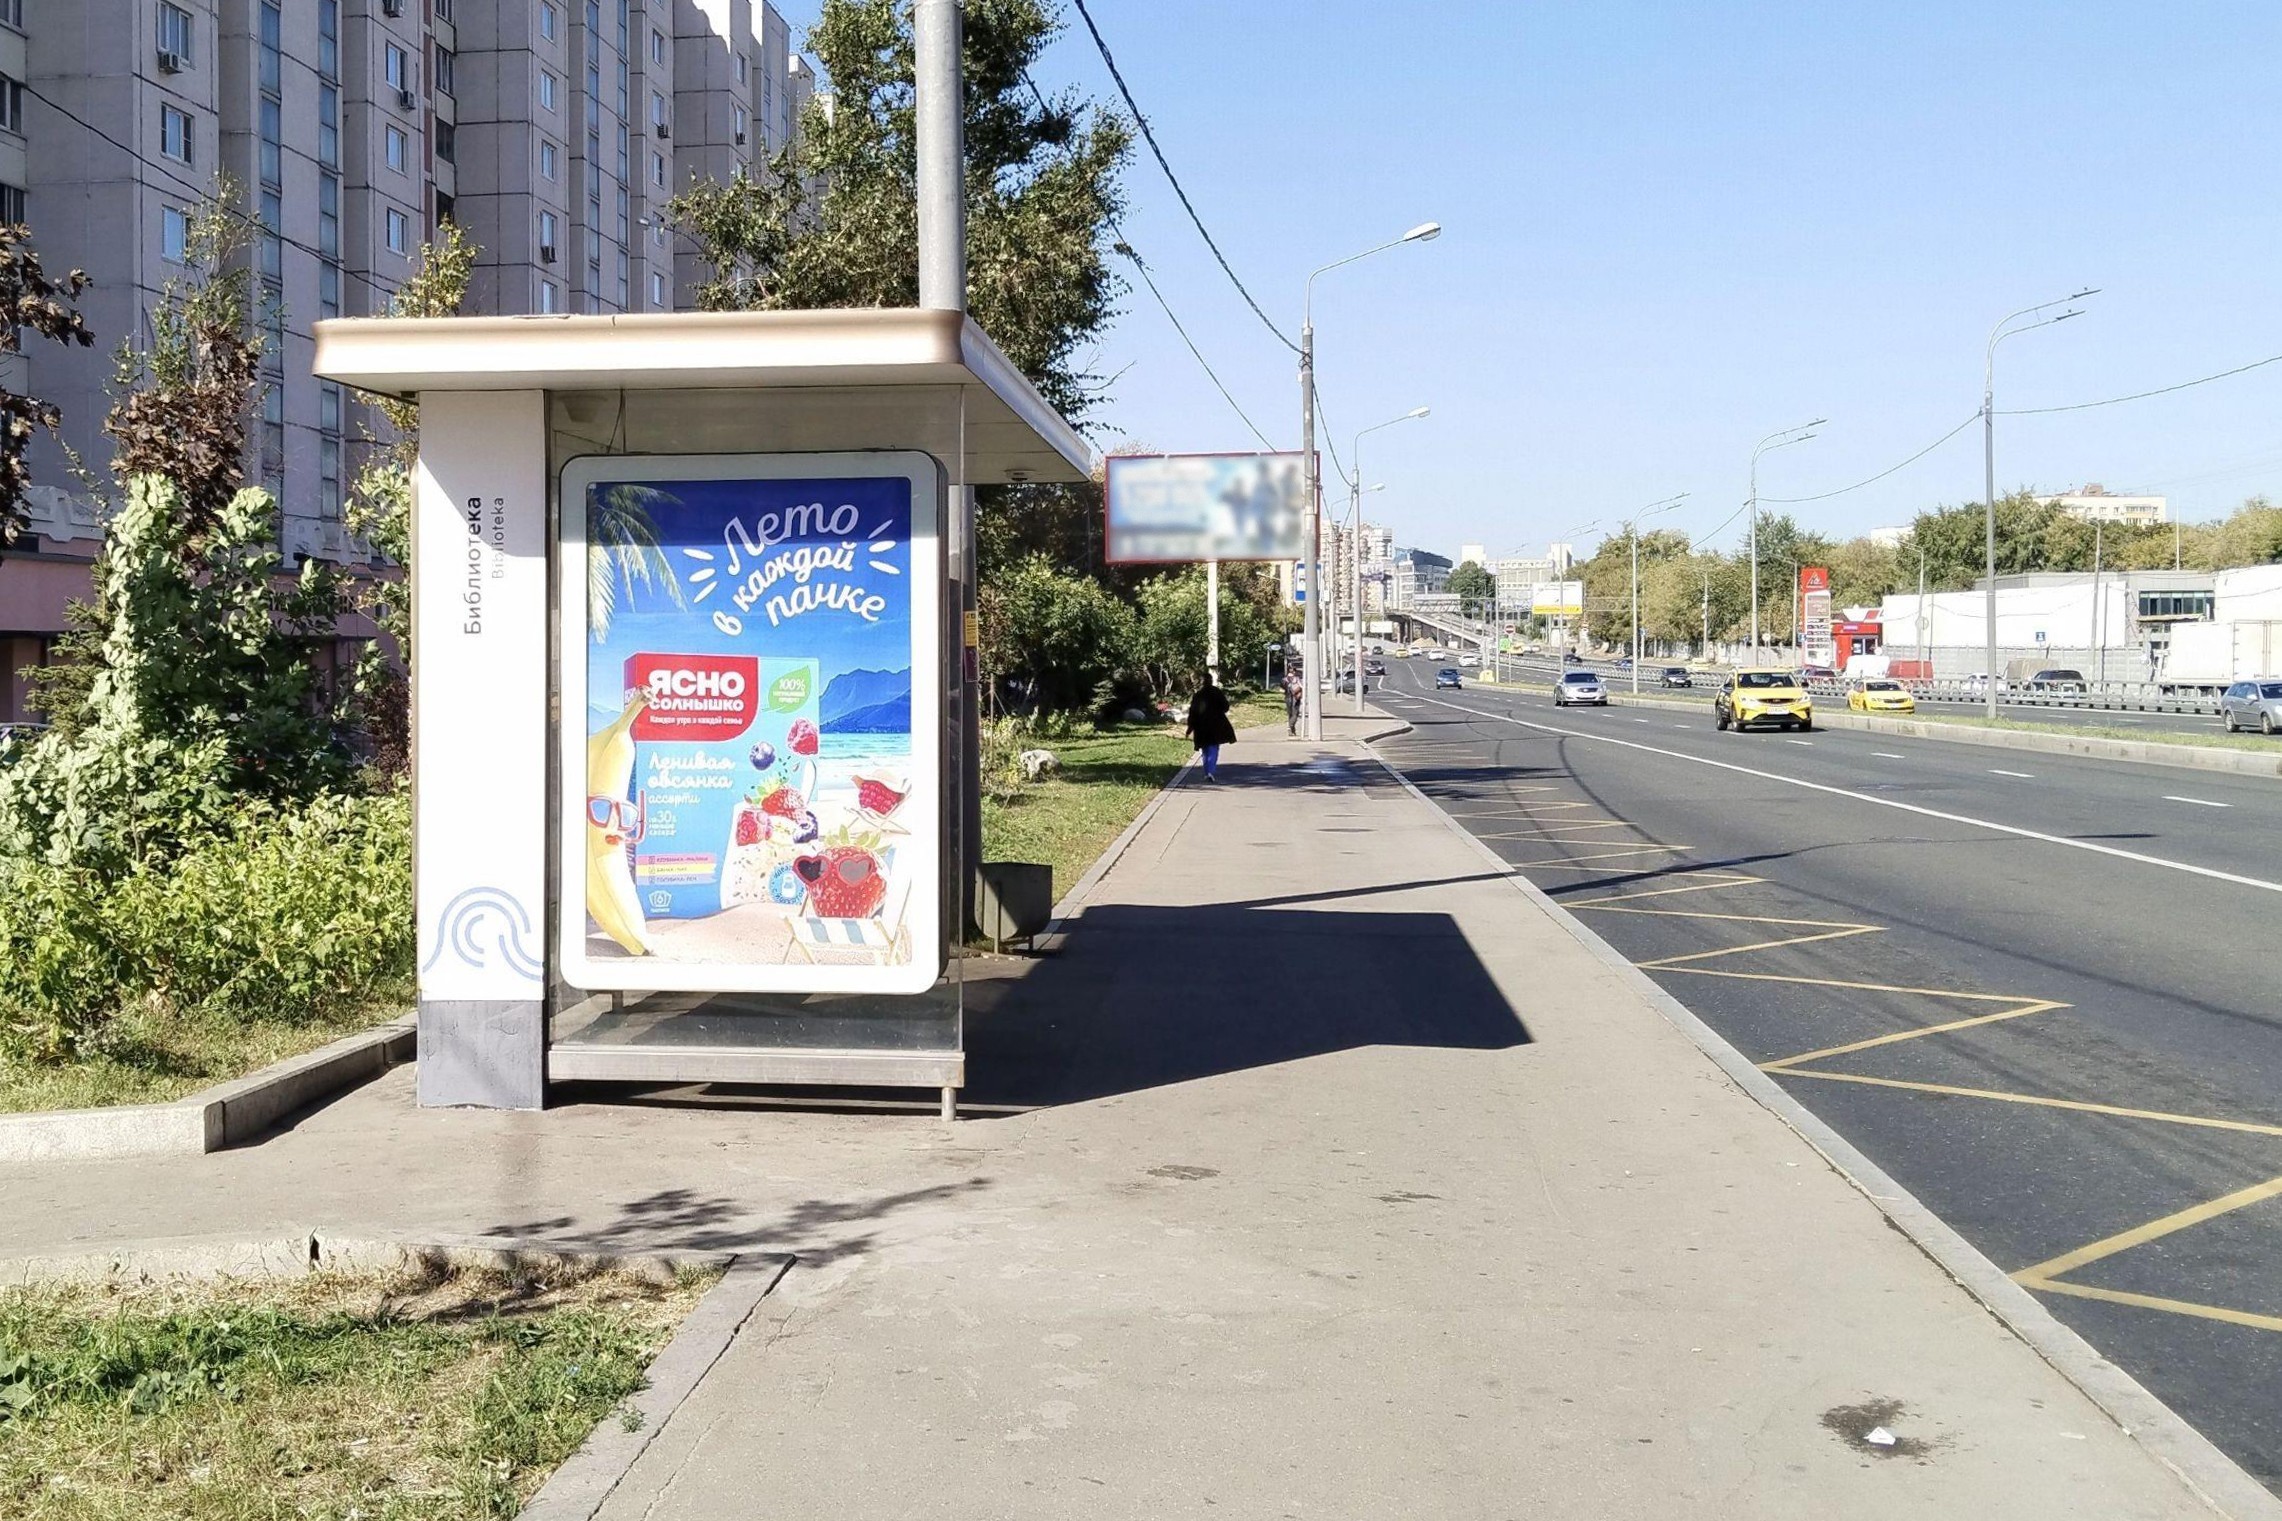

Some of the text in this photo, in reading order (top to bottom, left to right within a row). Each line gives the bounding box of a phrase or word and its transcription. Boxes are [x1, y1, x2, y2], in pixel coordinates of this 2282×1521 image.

[491, 497, 504, 579] Biblioteka
[723, 502, 859, 576] Лето
[464, 497, 481, 634] Библиотека
[712, 541, 857, 636] в каждой
[765, 583, 886, 628] пачке
[649, 669, 745, 697] ЯСНО
[779, 679, 805, 690] 100%
[649, 697, 744, 711] СОЛНЫШКО
[647, 768, 733, 788] овсянка
[648, 750, 736, 770] Ленивая
